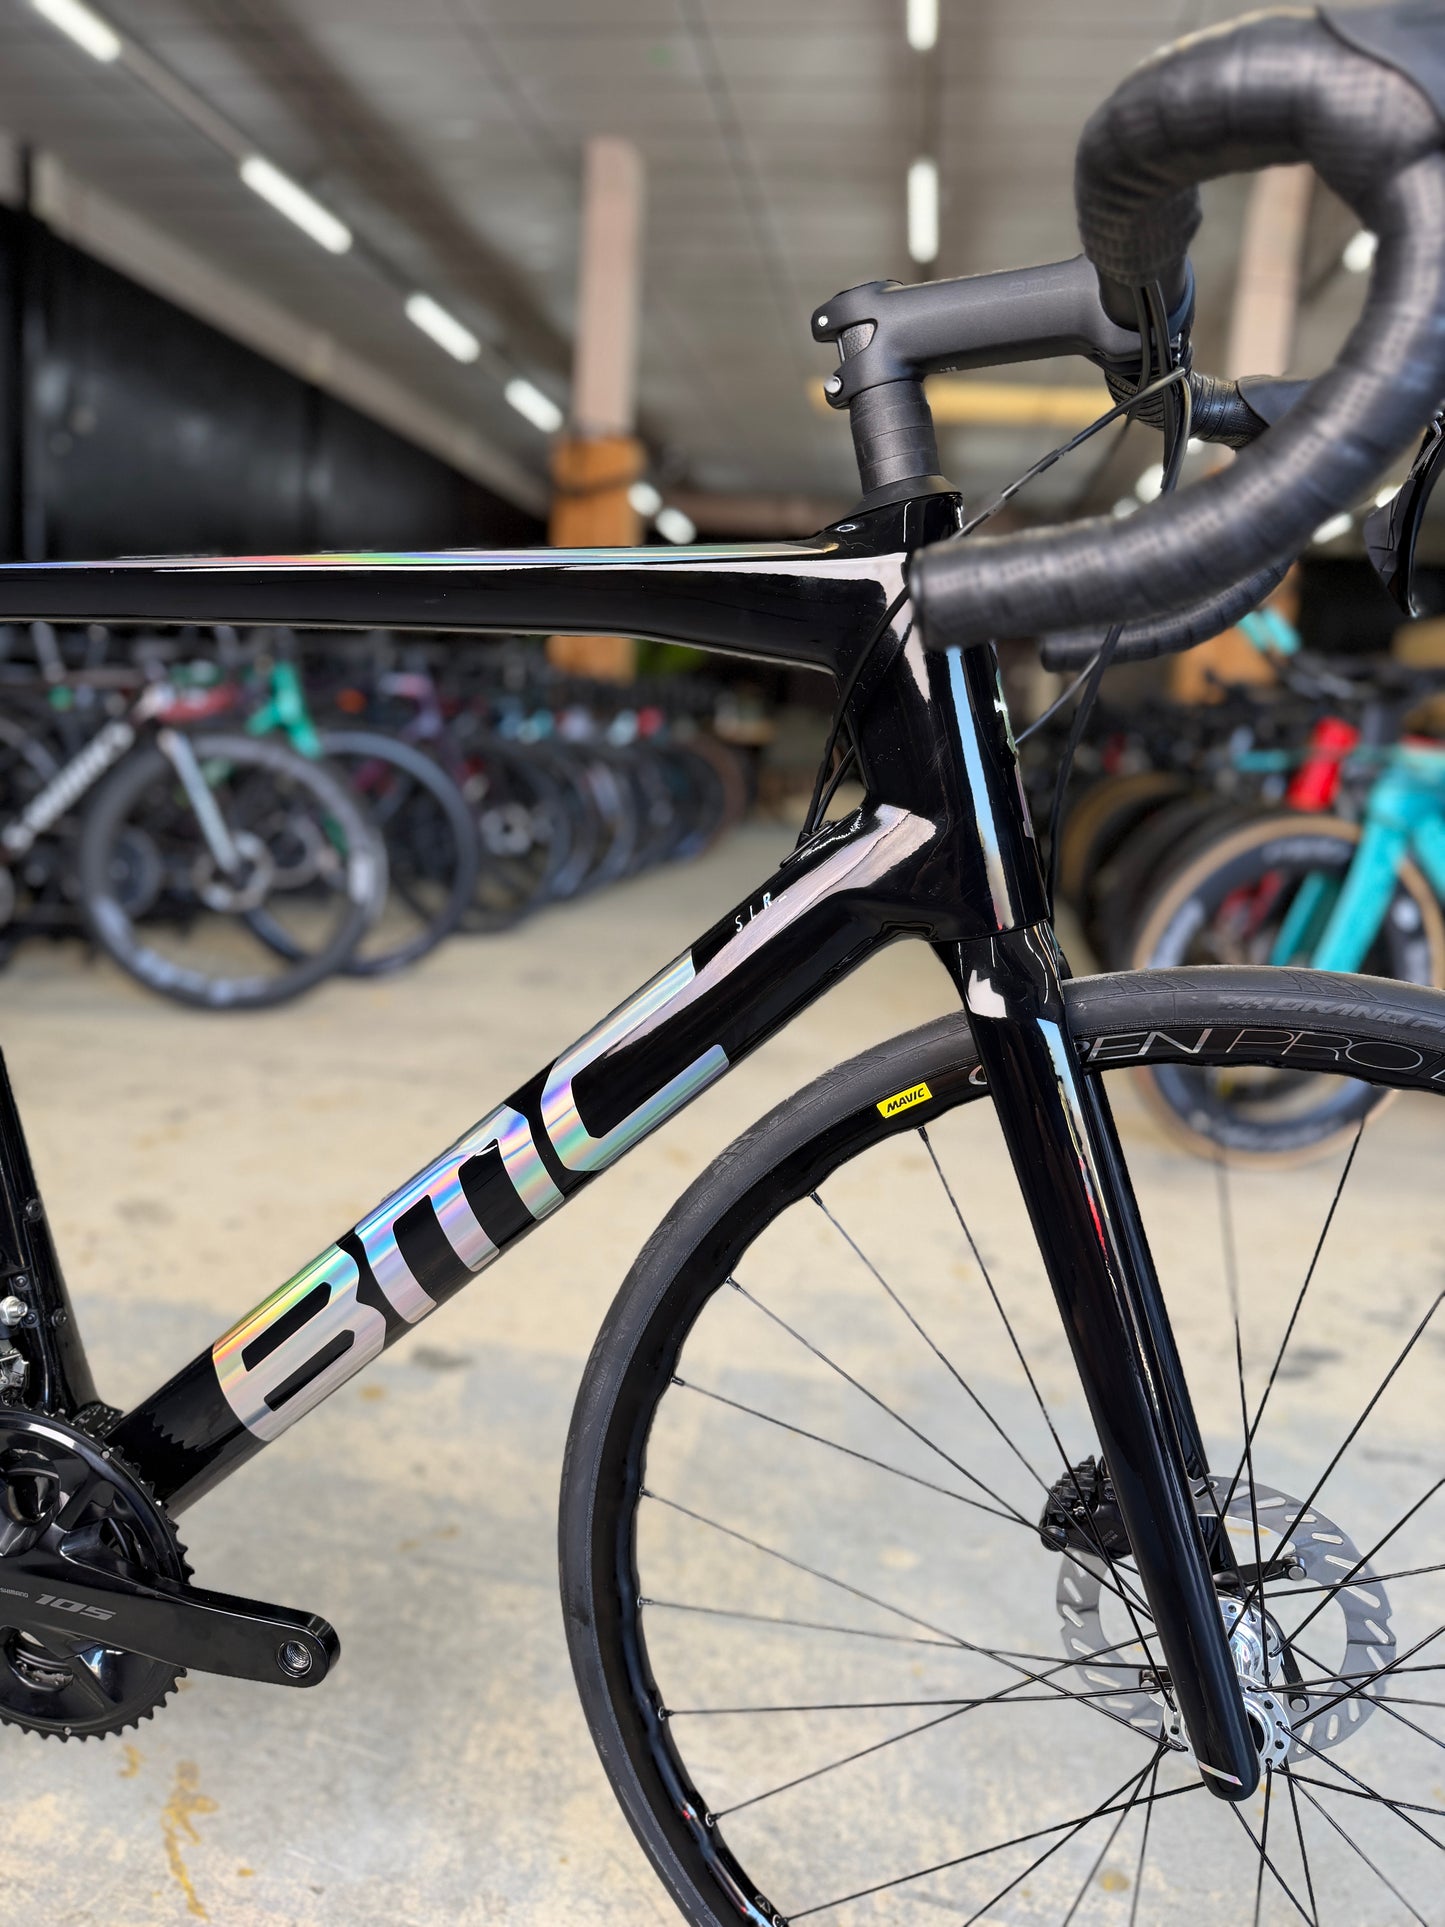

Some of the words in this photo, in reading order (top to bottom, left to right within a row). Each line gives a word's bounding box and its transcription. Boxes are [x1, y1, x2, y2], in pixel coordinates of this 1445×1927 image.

[1226, 1029, 1424, 1071] PRO
[887, 1088, 924, 1113] MAVIC
[212, 948, 730, 1442] BMC
[35, 1593, 117, 1621] 105
